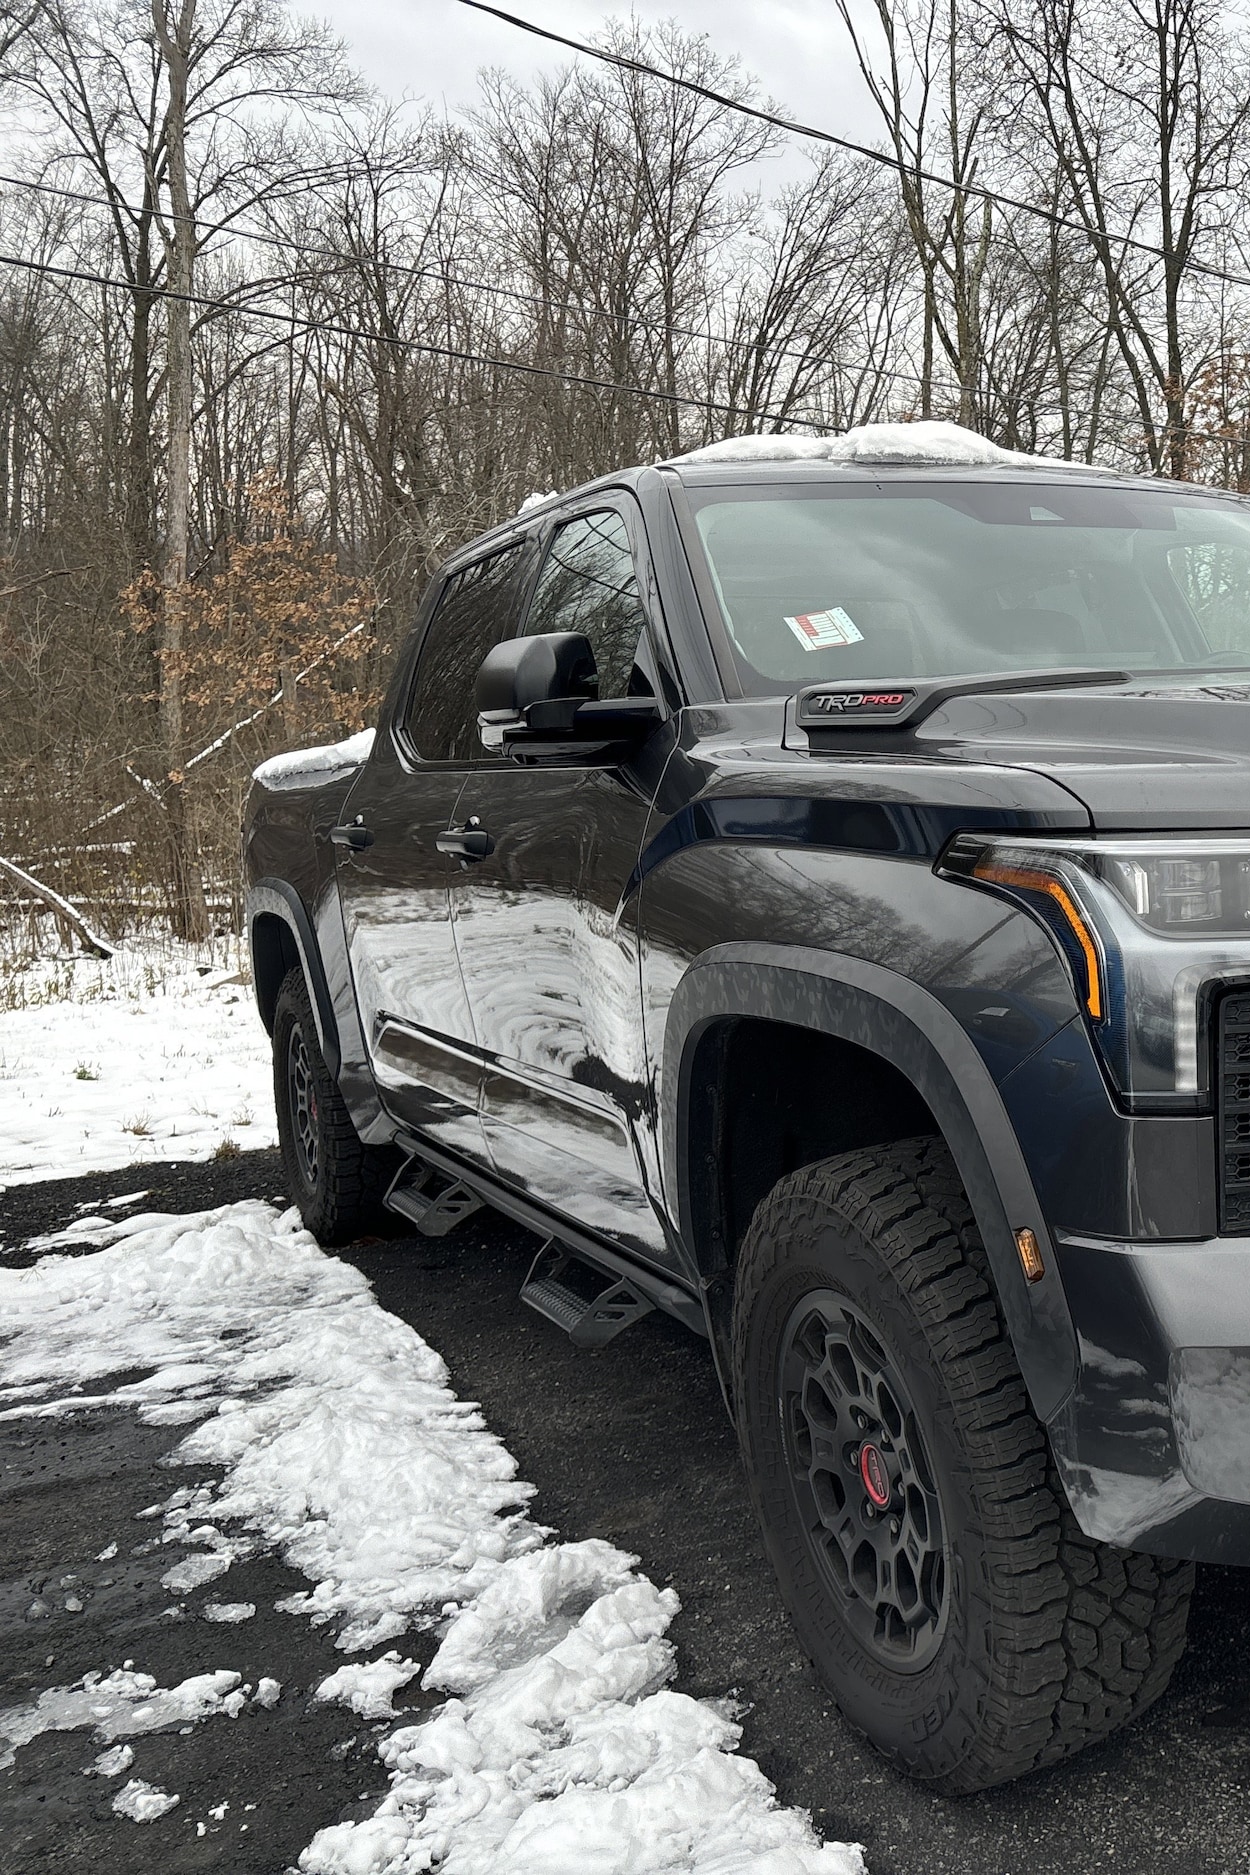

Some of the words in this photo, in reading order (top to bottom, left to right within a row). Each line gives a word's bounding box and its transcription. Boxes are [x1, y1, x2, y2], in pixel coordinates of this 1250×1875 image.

[816, 693, 864, 712] TRD
[861, 693, 904, 705] PRO
[870, 1449, 886, 1498] TRD
